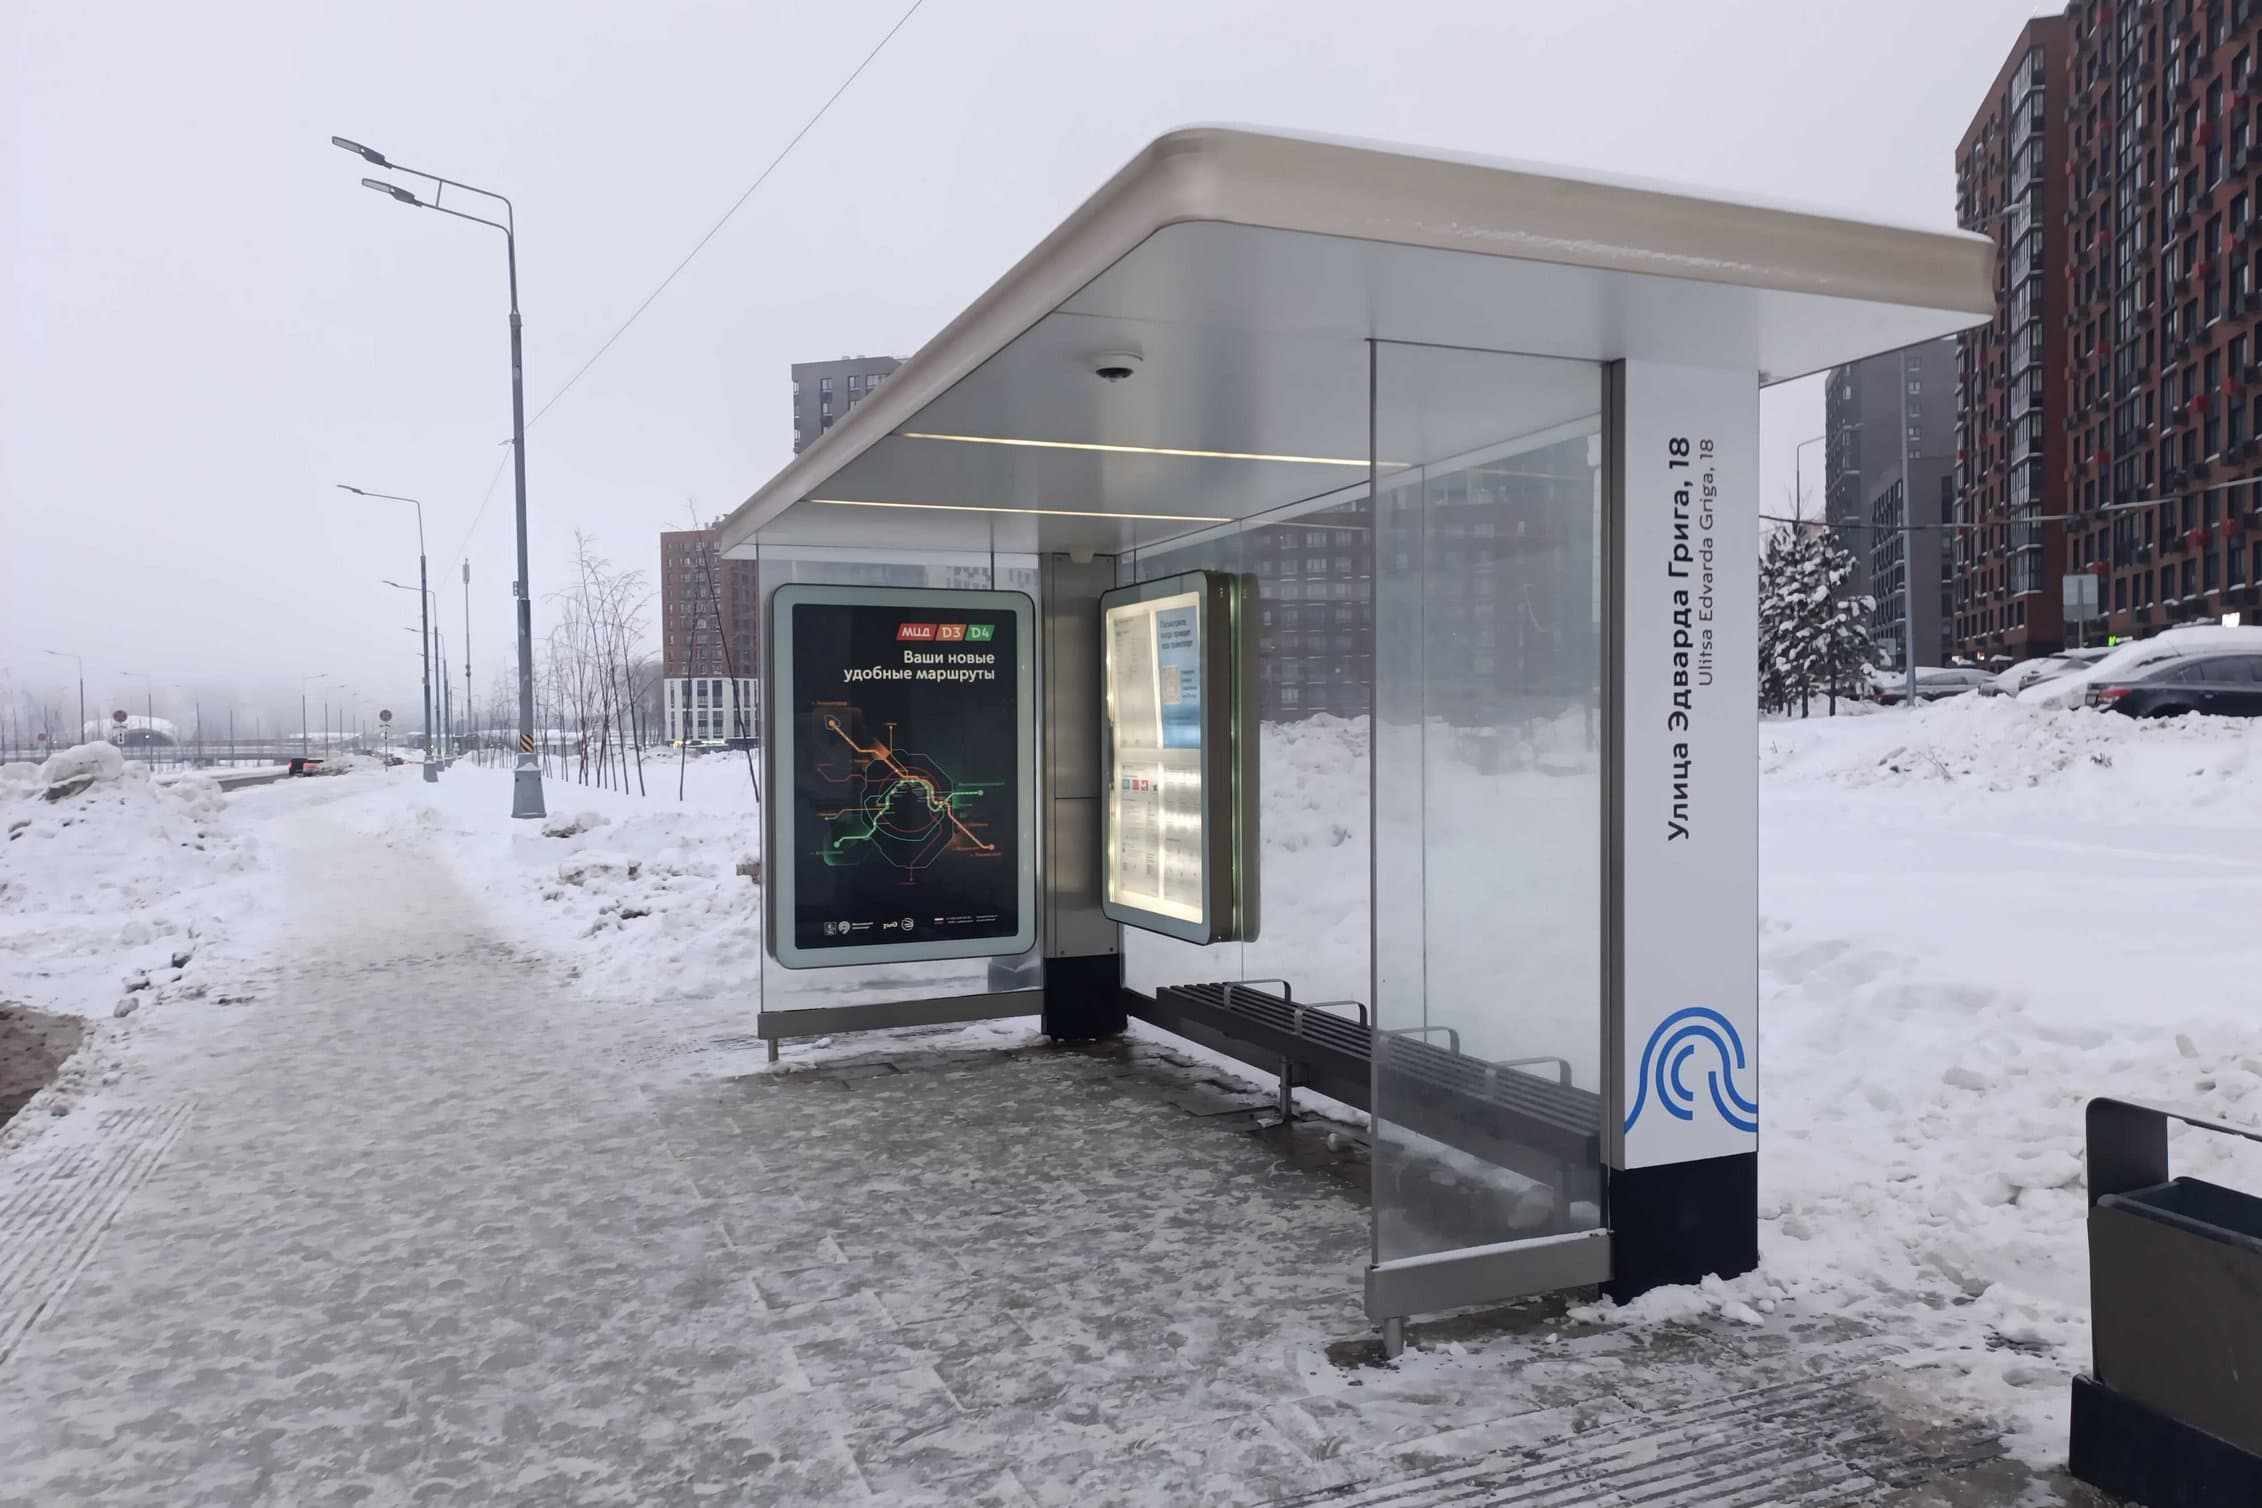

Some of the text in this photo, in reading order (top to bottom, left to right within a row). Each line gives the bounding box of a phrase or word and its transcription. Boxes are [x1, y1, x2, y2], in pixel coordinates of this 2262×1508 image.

[1698, 439, 1717, 686] Ulitsa Edvarda Griga, 18
[902, 627, 989, 638] МЦД D3 D4
[1668, 437, 1694, 841] Улица Эдварда Грига, 18
[904, 650, 995, 664] Ваши новые
[843, 665, 995, 683] удобные маршруты
